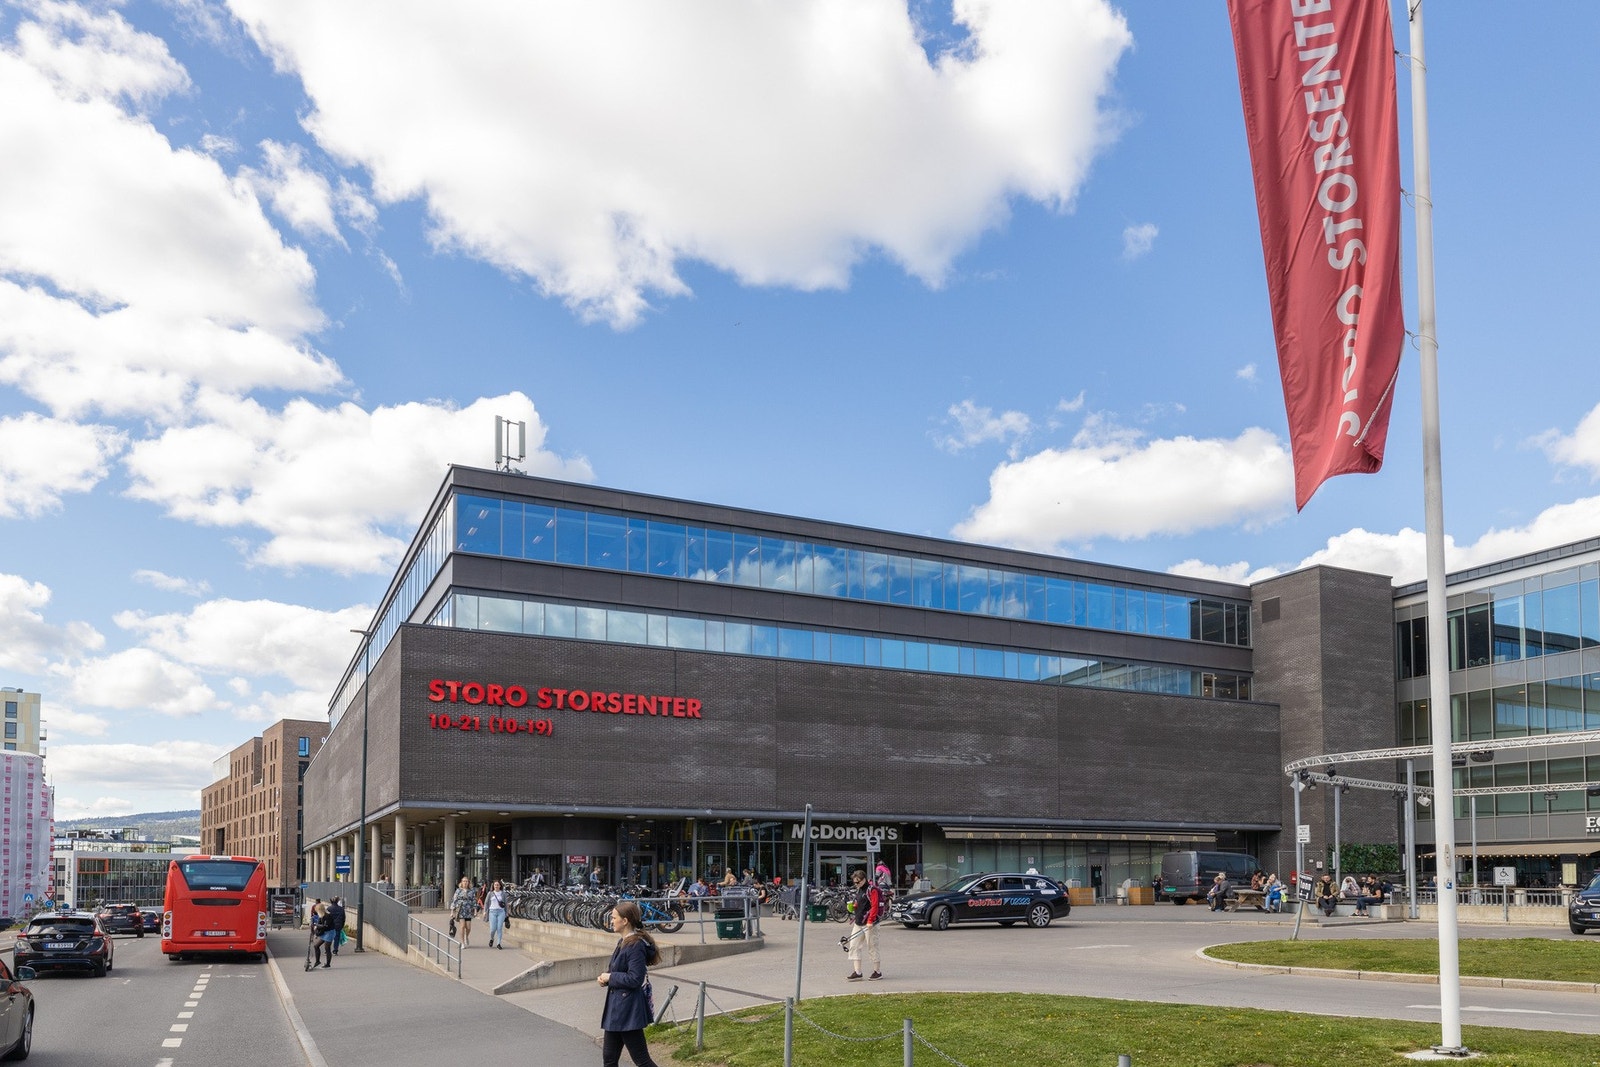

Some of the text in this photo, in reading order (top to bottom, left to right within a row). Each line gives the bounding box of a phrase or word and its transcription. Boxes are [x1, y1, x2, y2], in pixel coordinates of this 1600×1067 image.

[428, 679, 703, 718] STORO STORSENTER
[428, 713, 553, 736] 10-21 (10-19)
[791, 823, 898, 840] McDonald's
